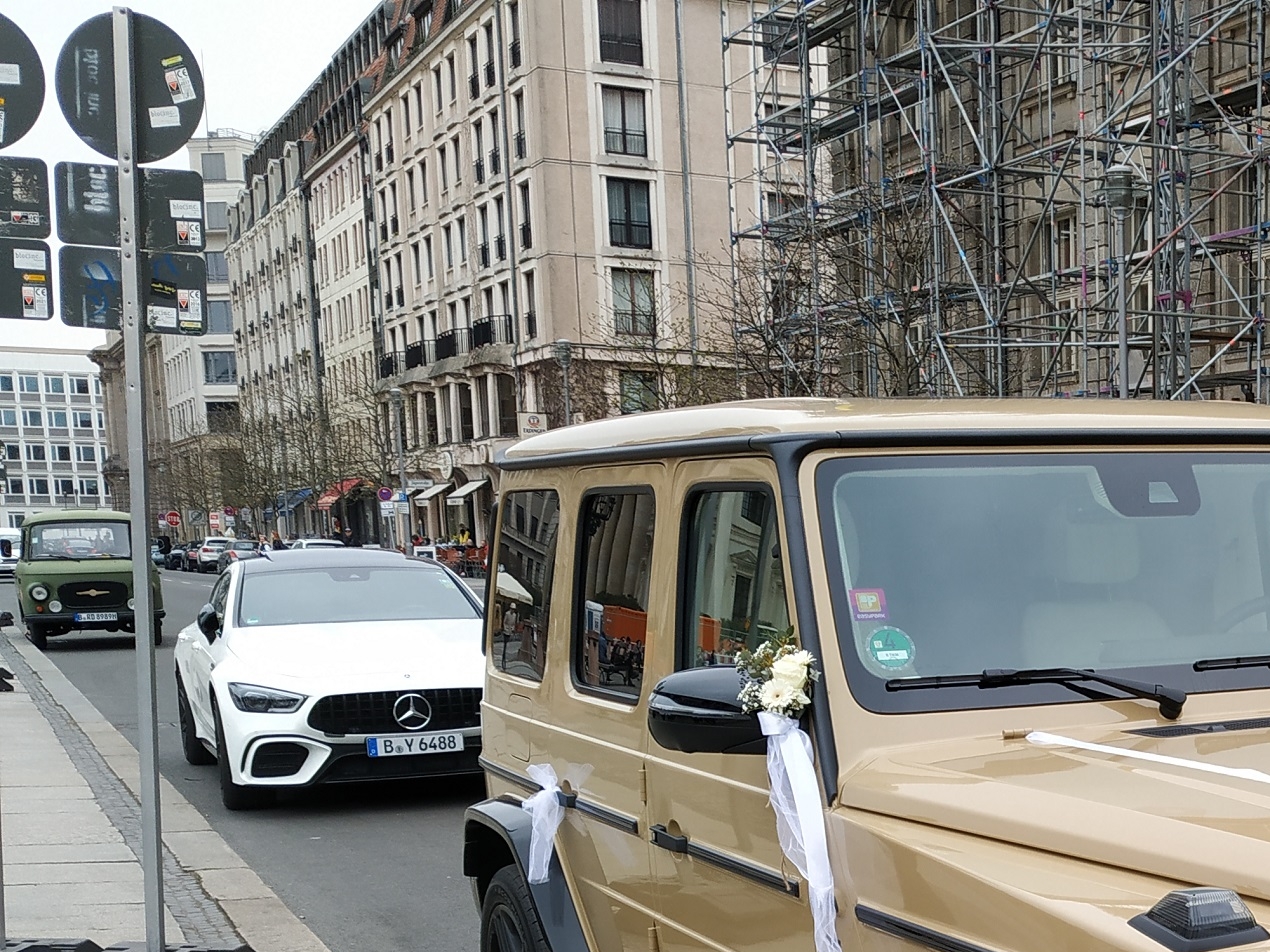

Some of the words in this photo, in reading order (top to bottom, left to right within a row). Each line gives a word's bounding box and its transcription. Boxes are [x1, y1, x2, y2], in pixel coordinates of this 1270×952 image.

[383, 739, 394, 753] B
[404, 738, 414, 752] Y
[419, 735, 456, 751] 6488
